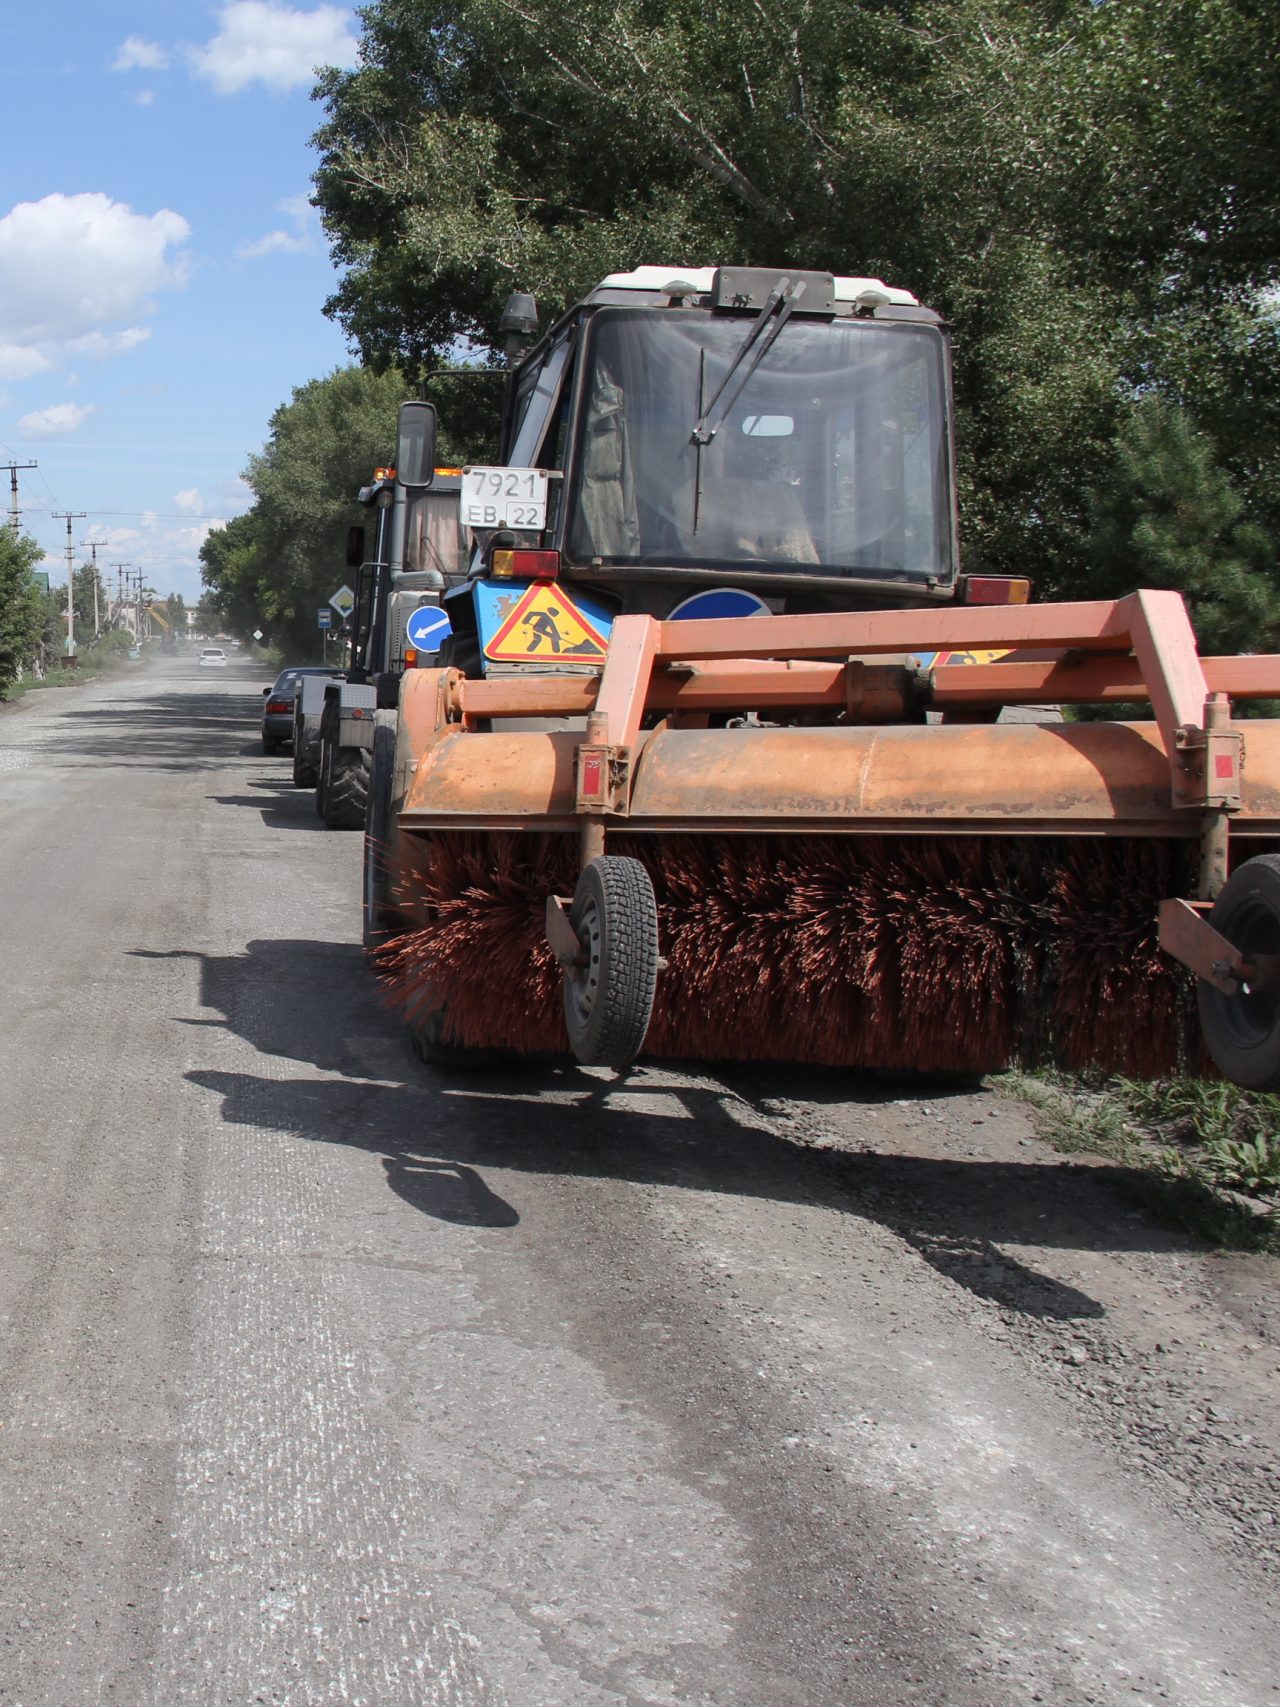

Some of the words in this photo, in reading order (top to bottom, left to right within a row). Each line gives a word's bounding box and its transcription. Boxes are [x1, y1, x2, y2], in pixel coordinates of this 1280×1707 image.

[473, 472, 535, 498] 7921
[468, 504, 497, 523] ЕВ
[514, 507, 538, 526] 22
